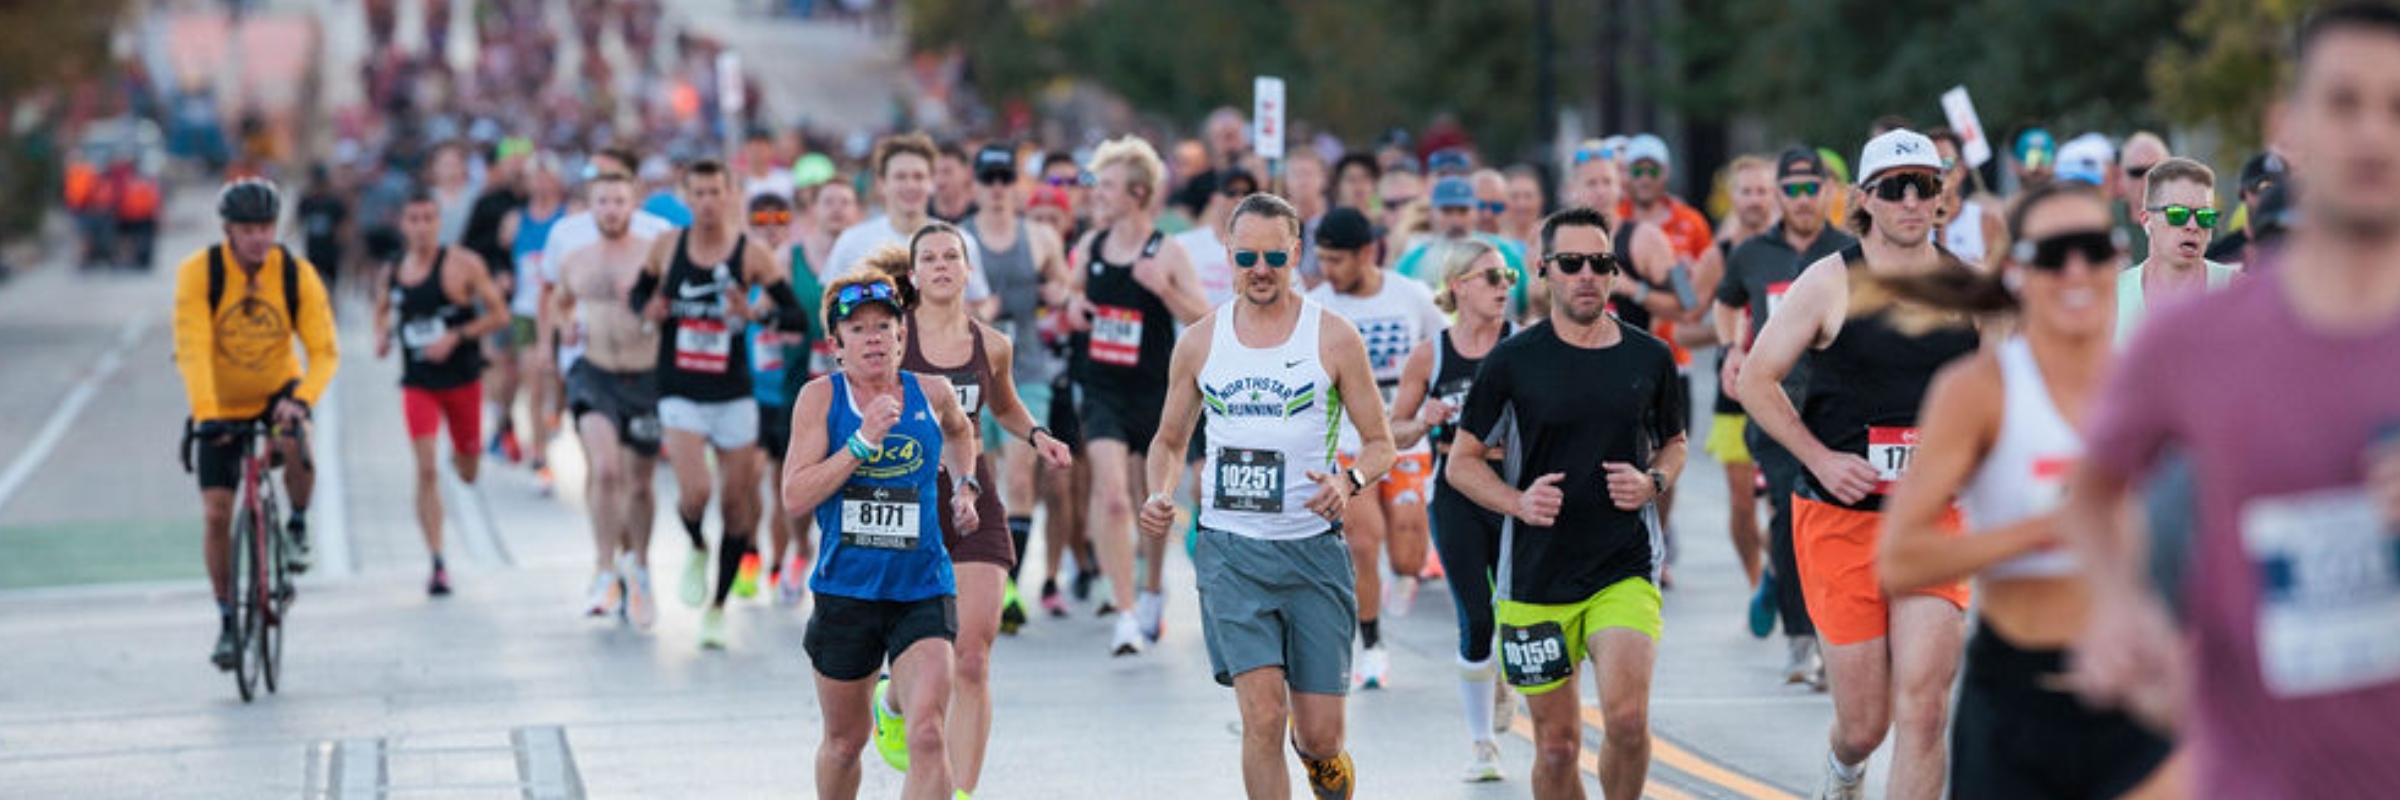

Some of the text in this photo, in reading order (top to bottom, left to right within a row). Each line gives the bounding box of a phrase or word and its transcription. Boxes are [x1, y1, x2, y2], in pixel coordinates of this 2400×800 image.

[1228, 403, 1282, 417] RUNNING
[1221, 464, 1277, 490] 10251
[860, 502, 904, 527] 8171
[1504, 638, 1561, 665] 10159
